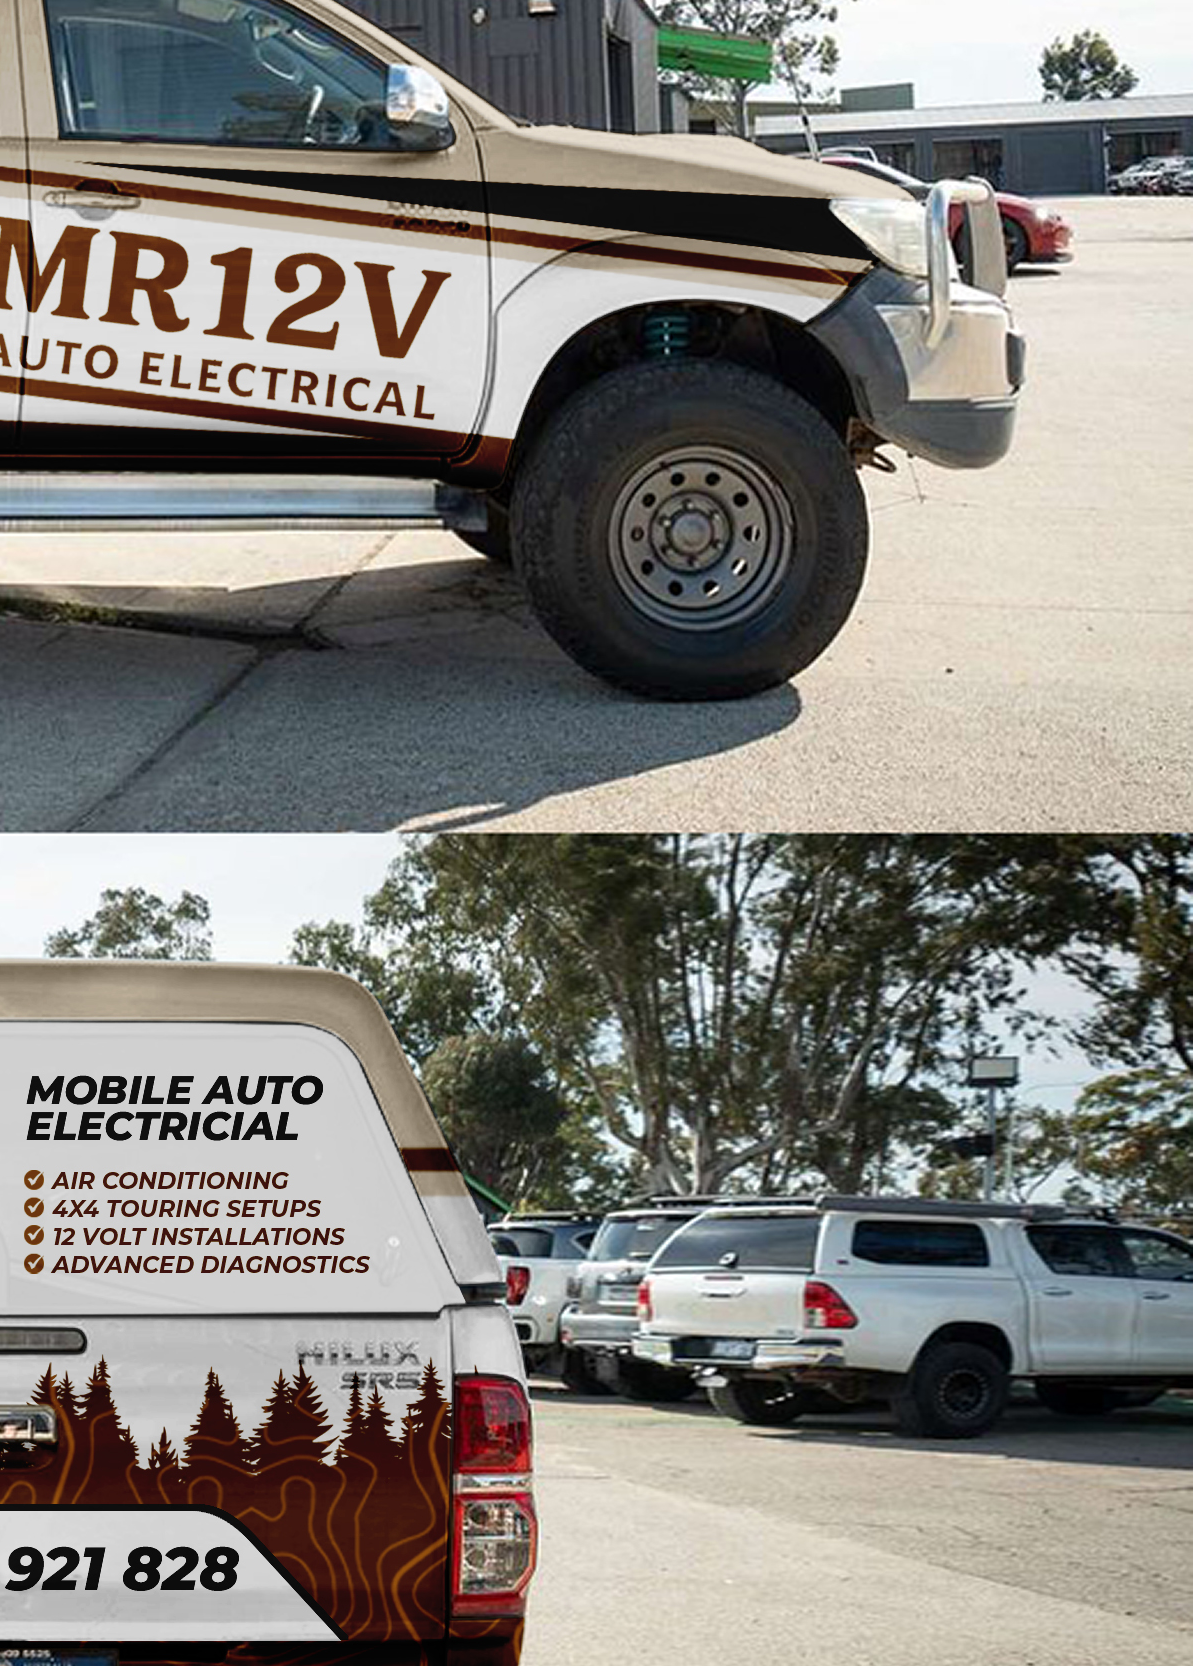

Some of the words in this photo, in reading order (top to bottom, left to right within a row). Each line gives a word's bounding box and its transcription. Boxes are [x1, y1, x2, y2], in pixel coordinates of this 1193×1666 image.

[139, 351, 435, 420] ELECTRICAL
[26, 1075, 194, 1105] MOBILE
[202, 1075, 324, 1105] AUTO
[26, 1111, 299, 1141] ELECTRICIAL
[51, 1171, 95, 1190] AIR
[103, 1171, 289, 1190] CONDITIONING
[52, 1199, 100, 1218] 4X4
[107, 1199, 220, 1218] TOURING
[226, 1199, 322, 1218] SETUPS
[53, 1227, 76, 1246] 12
[83, 1227, 147, 1246] VOLT
[151, 1227, 346, 1246] INSTALLATIONS
[51, 1255, 195, 1274] ADVANCED
[200, 1255, 371, 1274] DIAGNOSTICS
[4, 1545, 107, 1592] 921
[122, 1545, 241, 1592] 828
